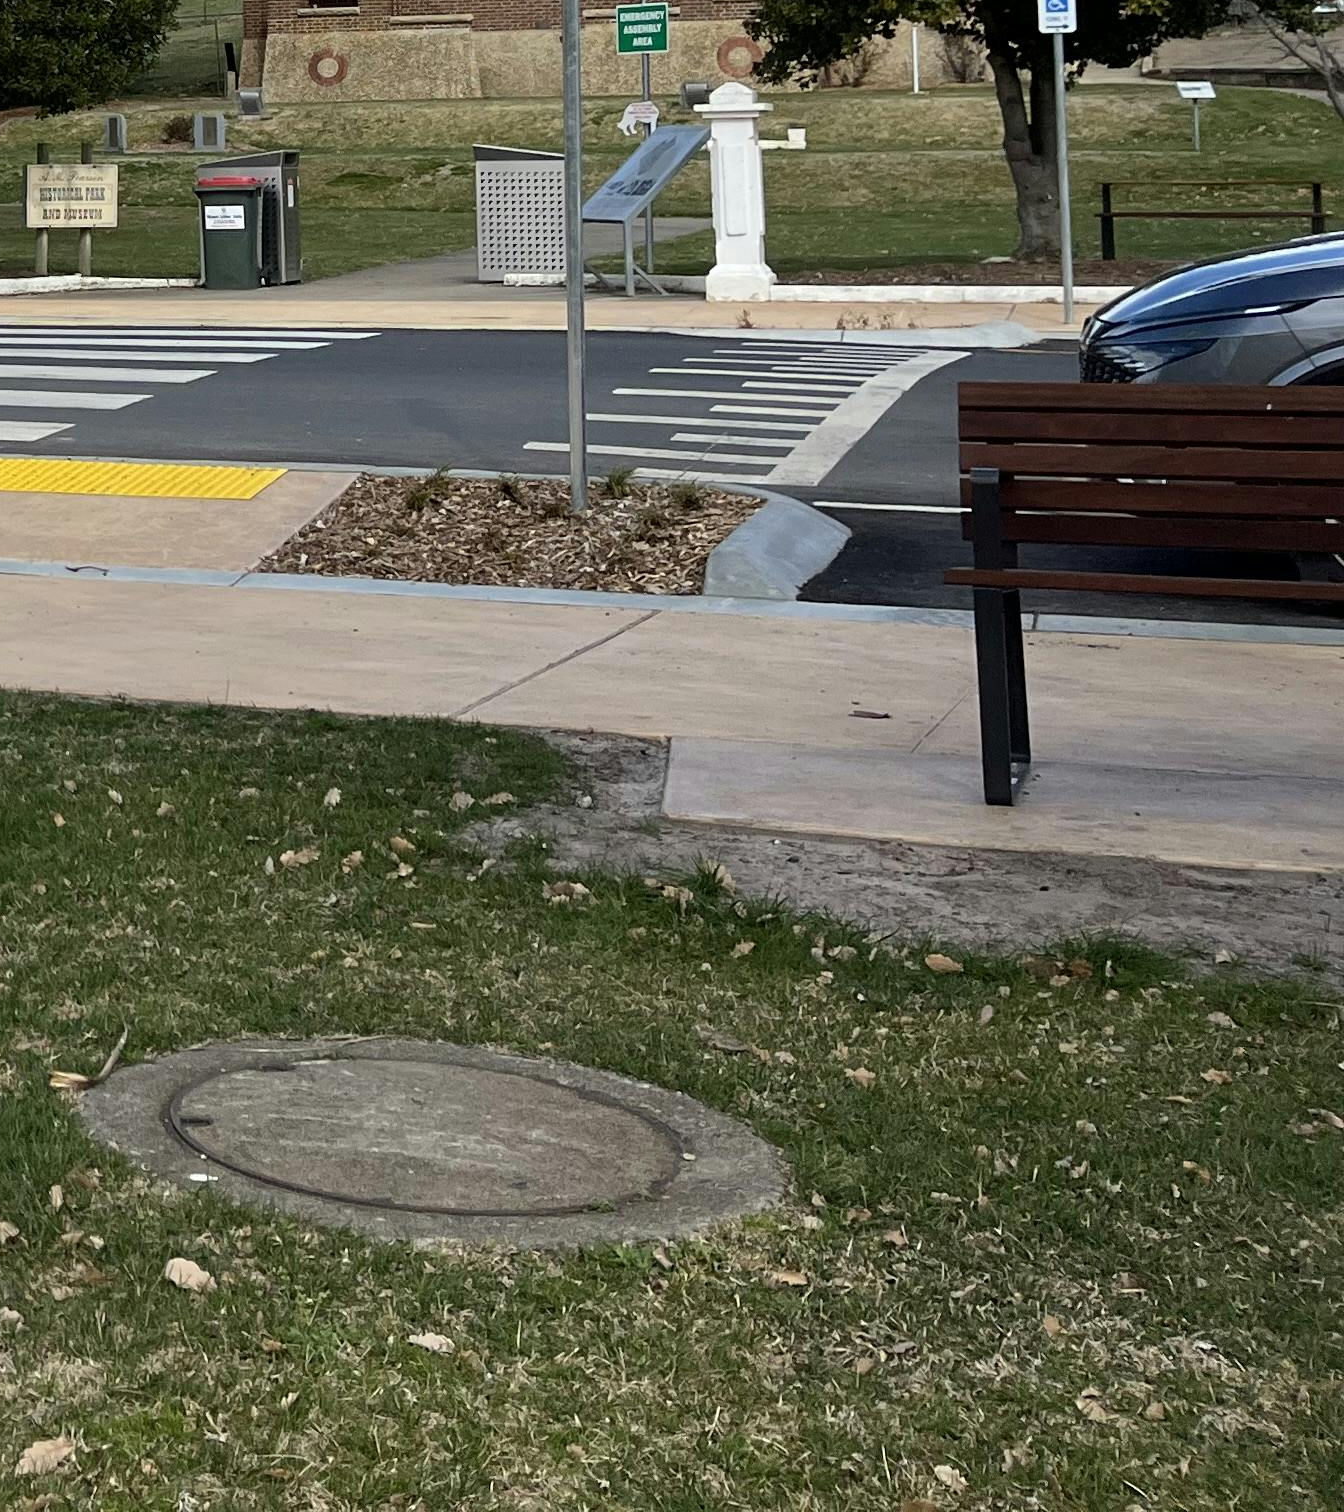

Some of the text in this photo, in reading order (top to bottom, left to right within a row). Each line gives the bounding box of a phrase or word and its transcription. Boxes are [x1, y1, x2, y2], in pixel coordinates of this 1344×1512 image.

[619, 11, 665, 22] EMERGENCY
[623, 23, 662, 35] ASSEMBLY
[632, 37, 653, 47] AREA
[42, 208, 103, 220] AND MUSEUM
